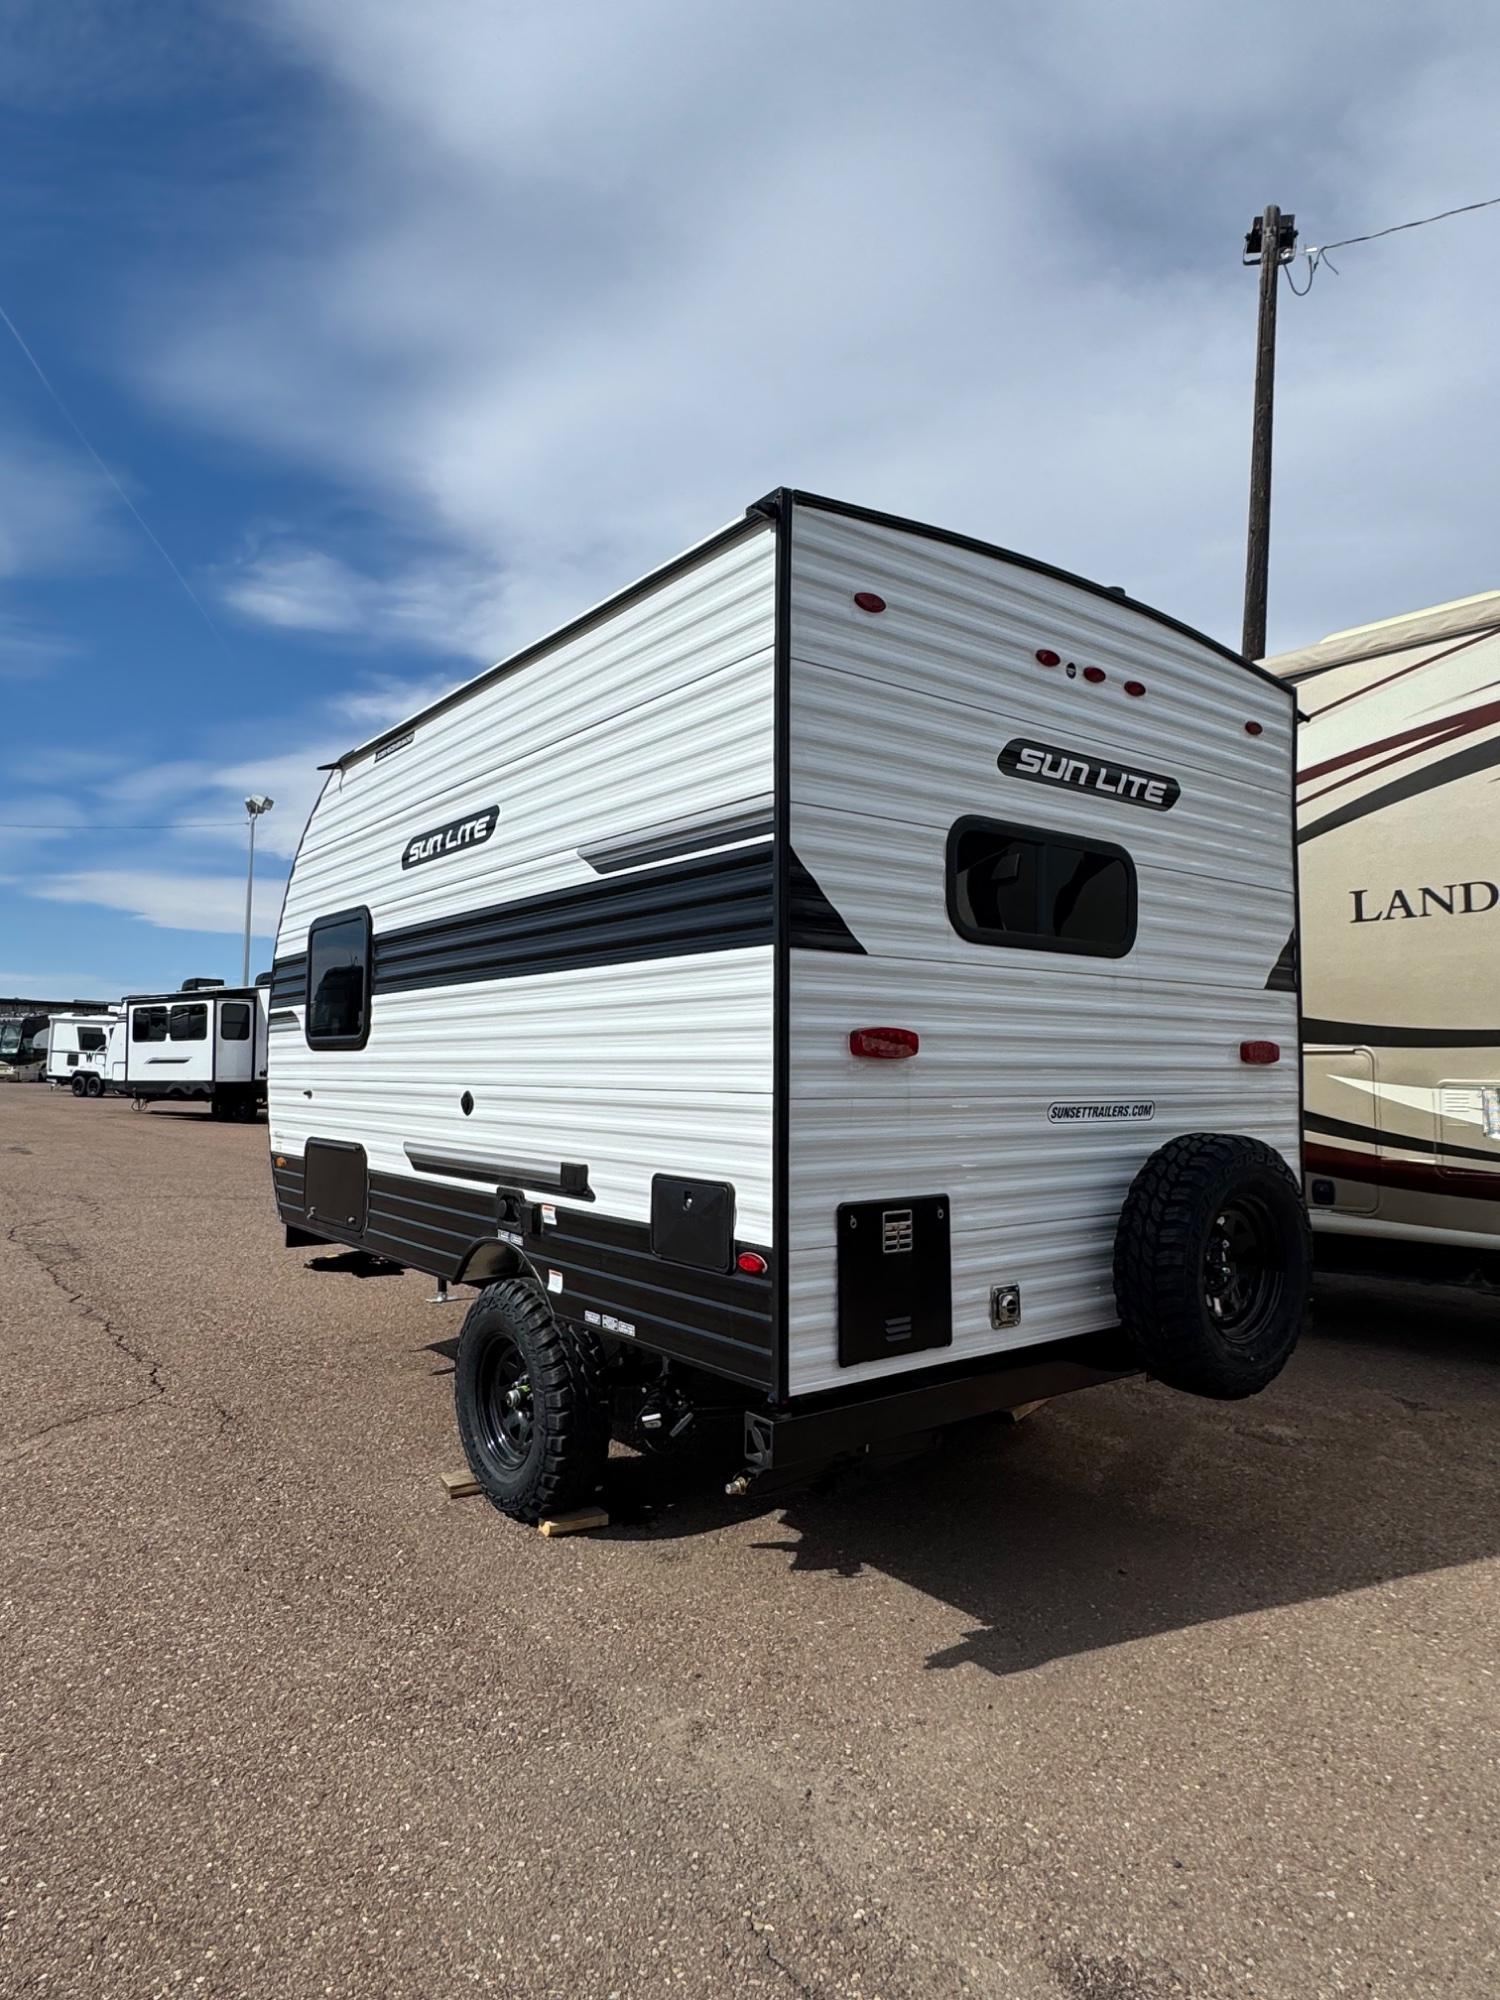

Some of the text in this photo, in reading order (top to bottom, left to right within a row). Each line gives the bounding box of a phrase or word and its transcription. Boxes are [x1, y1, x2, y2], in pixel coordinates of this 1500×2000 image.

[1015, 748, 1168, 804] SUN LITE
[408, 815, 491, 863] SUN LITE
[1348, 881, 1500, 924] LAND
[1050, 1104, 1153, 1119] SUNSETTRAILERS.COM
